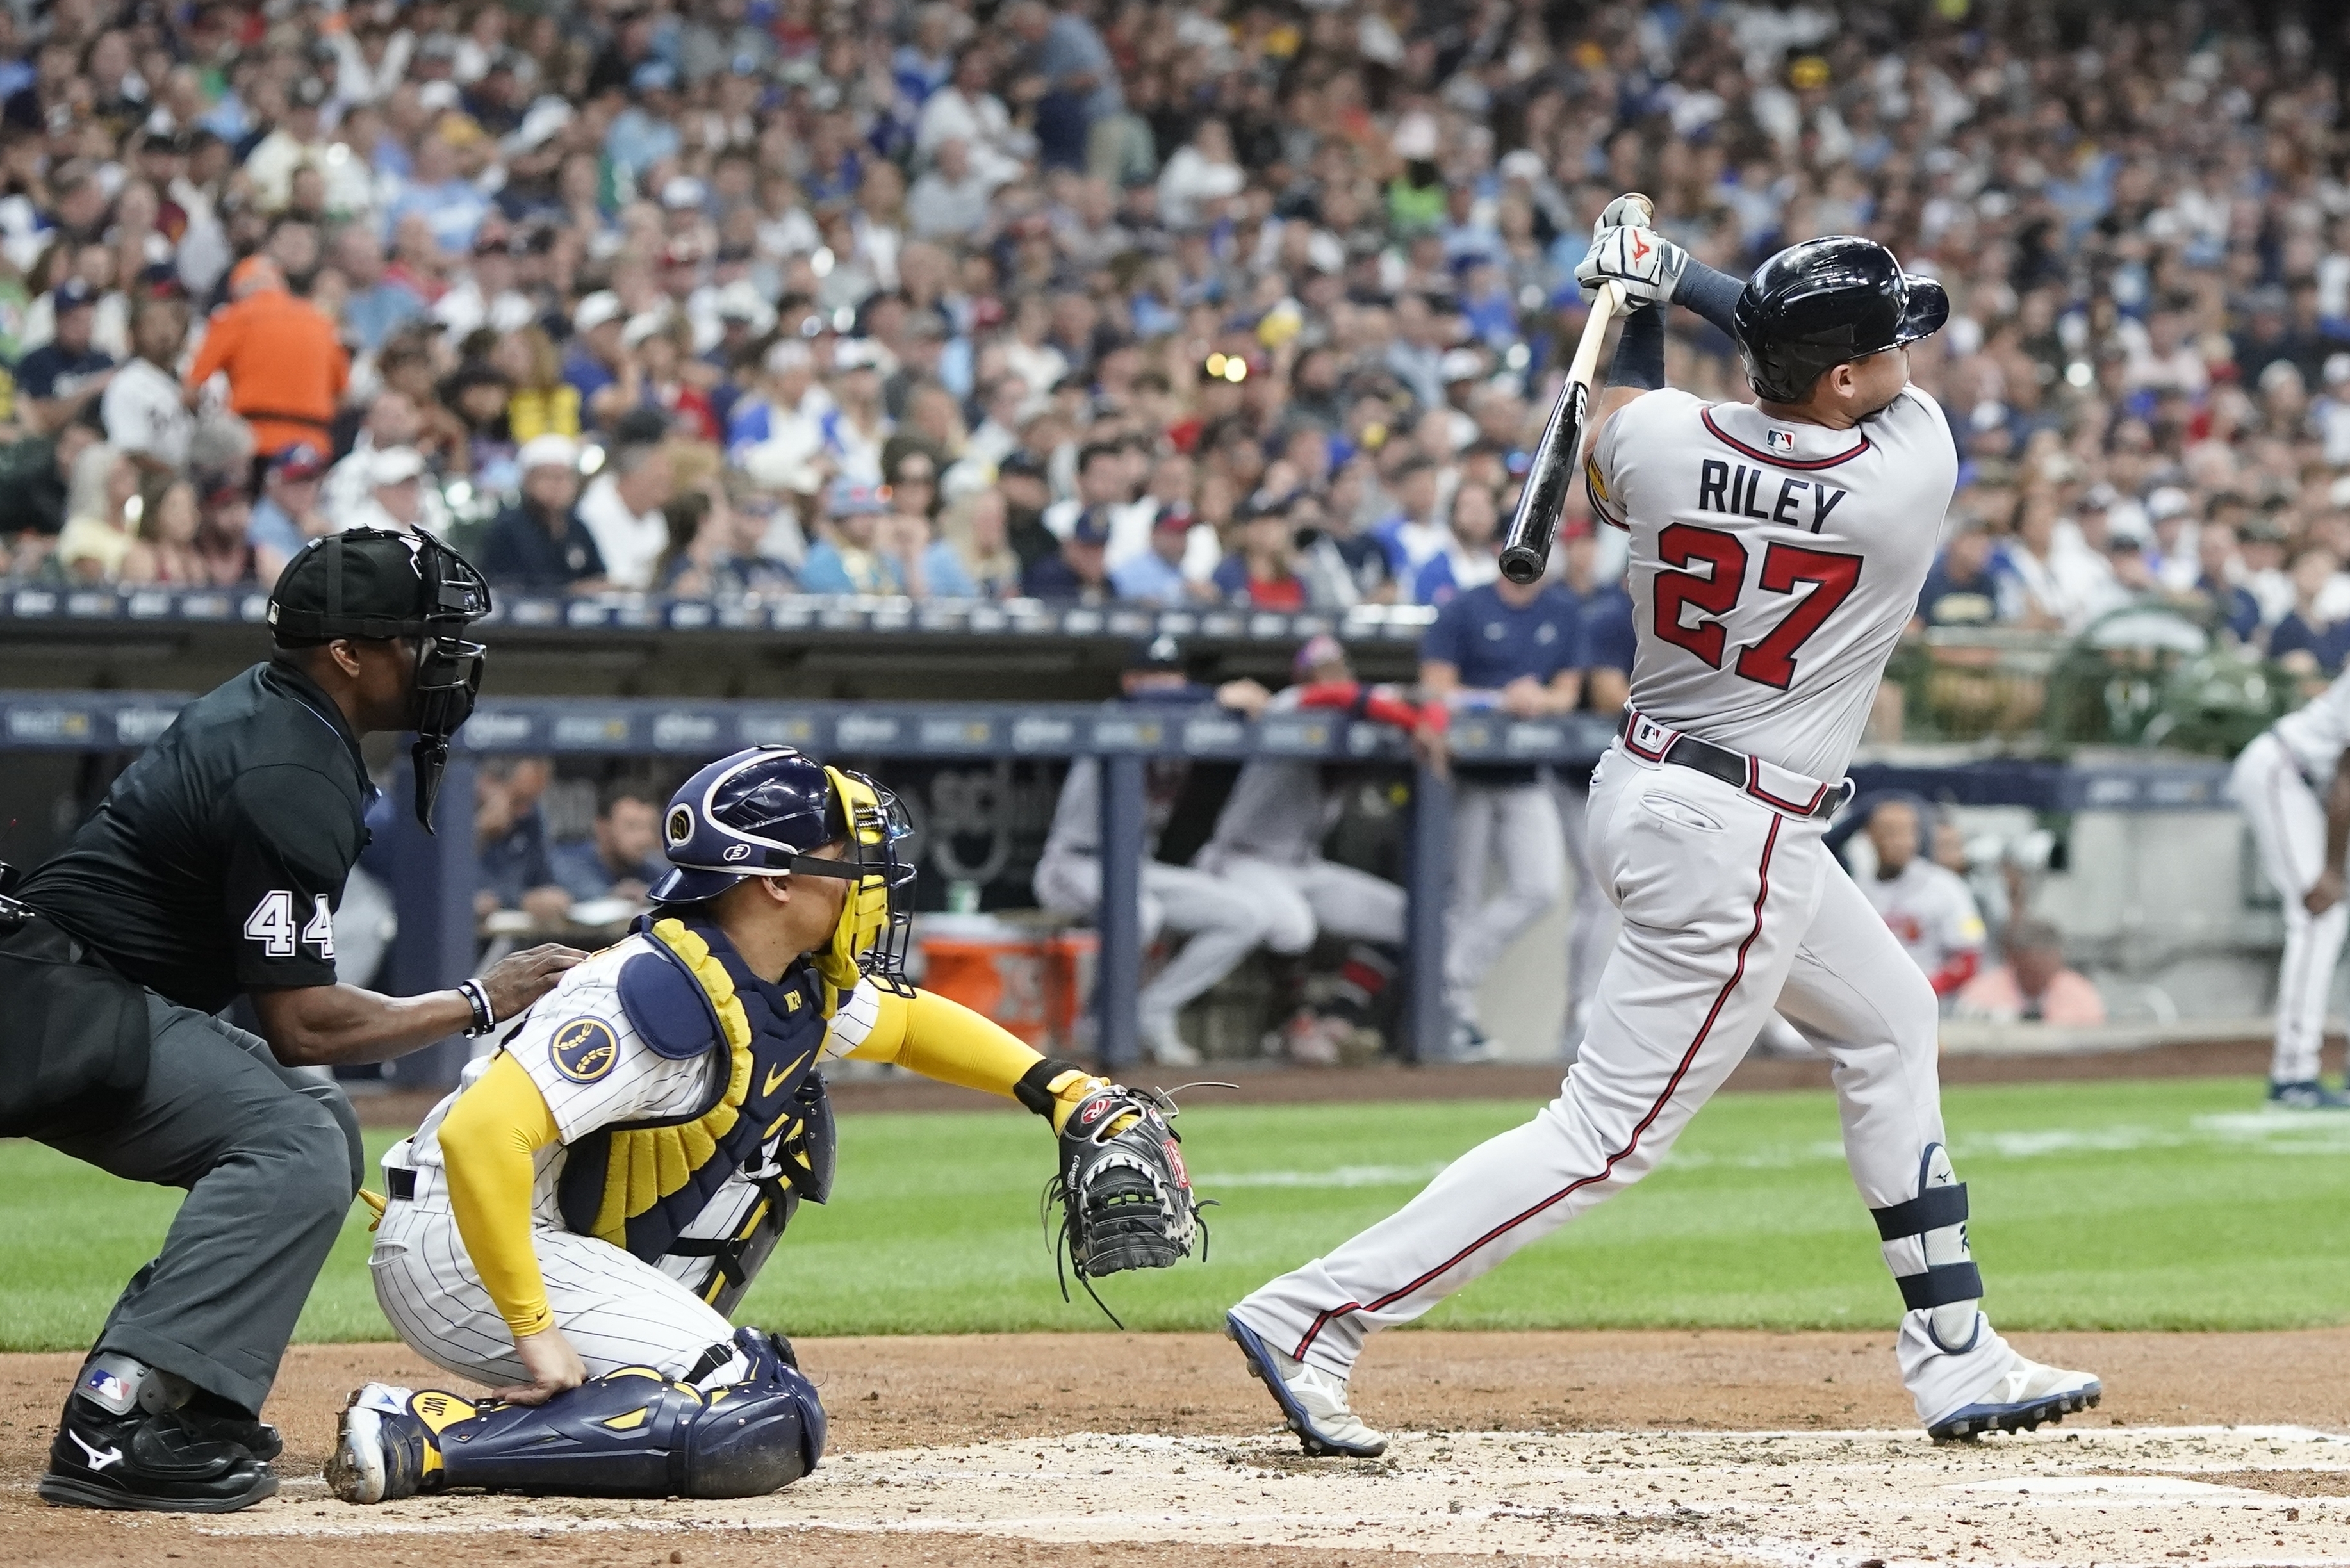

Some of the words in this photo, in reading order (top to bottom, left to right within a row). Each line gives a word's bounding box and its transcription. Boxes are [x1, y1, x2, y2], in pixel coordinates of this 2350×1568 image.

[1699, 459, 1846, 534] RILEY
[1653, 522, 1864, 690] 27
[243, 890, 335, 959] 44
[422, 1397, 448, 1416] WC
